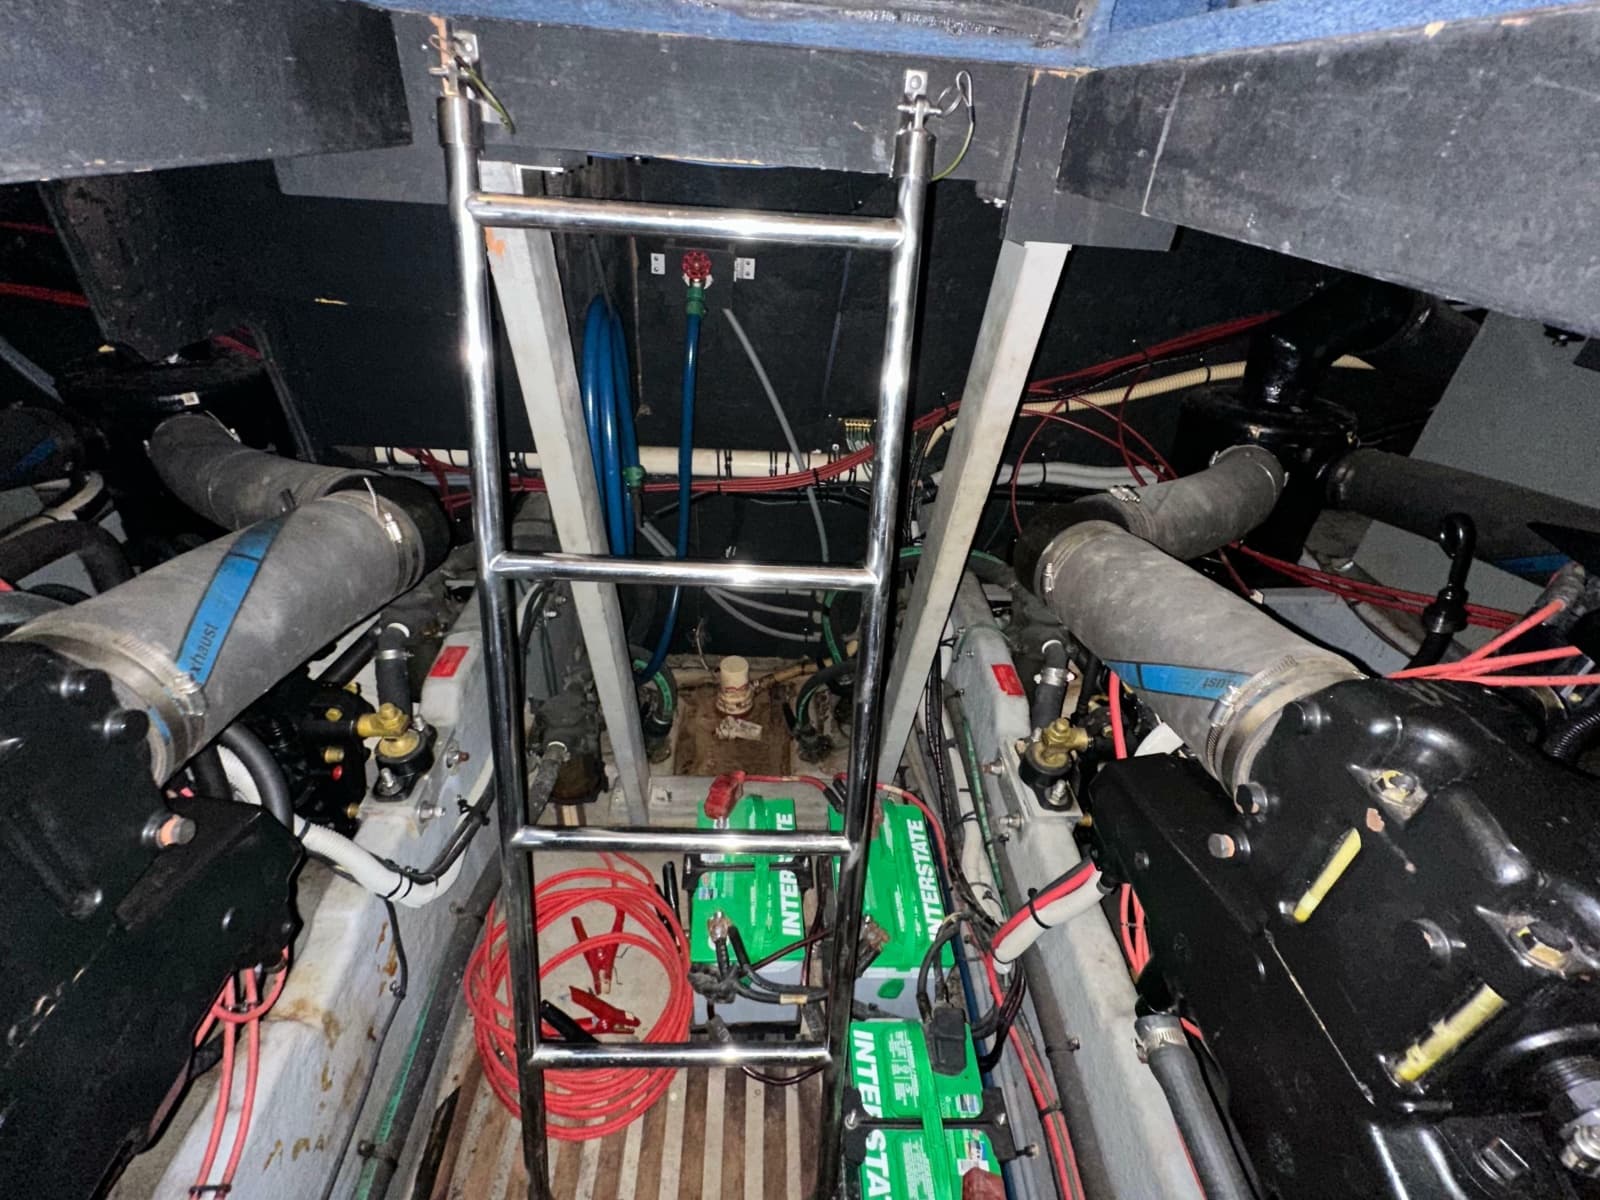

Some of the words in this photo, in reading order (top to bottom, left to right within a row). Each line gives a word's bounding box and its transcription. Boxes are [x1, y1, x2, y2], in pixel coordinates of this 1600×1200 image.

[189, 623, 219, 673] xhaust
[775, 812, 801, 936] INTERSTE
[853, 1029, 893, 1200] INTESTA
